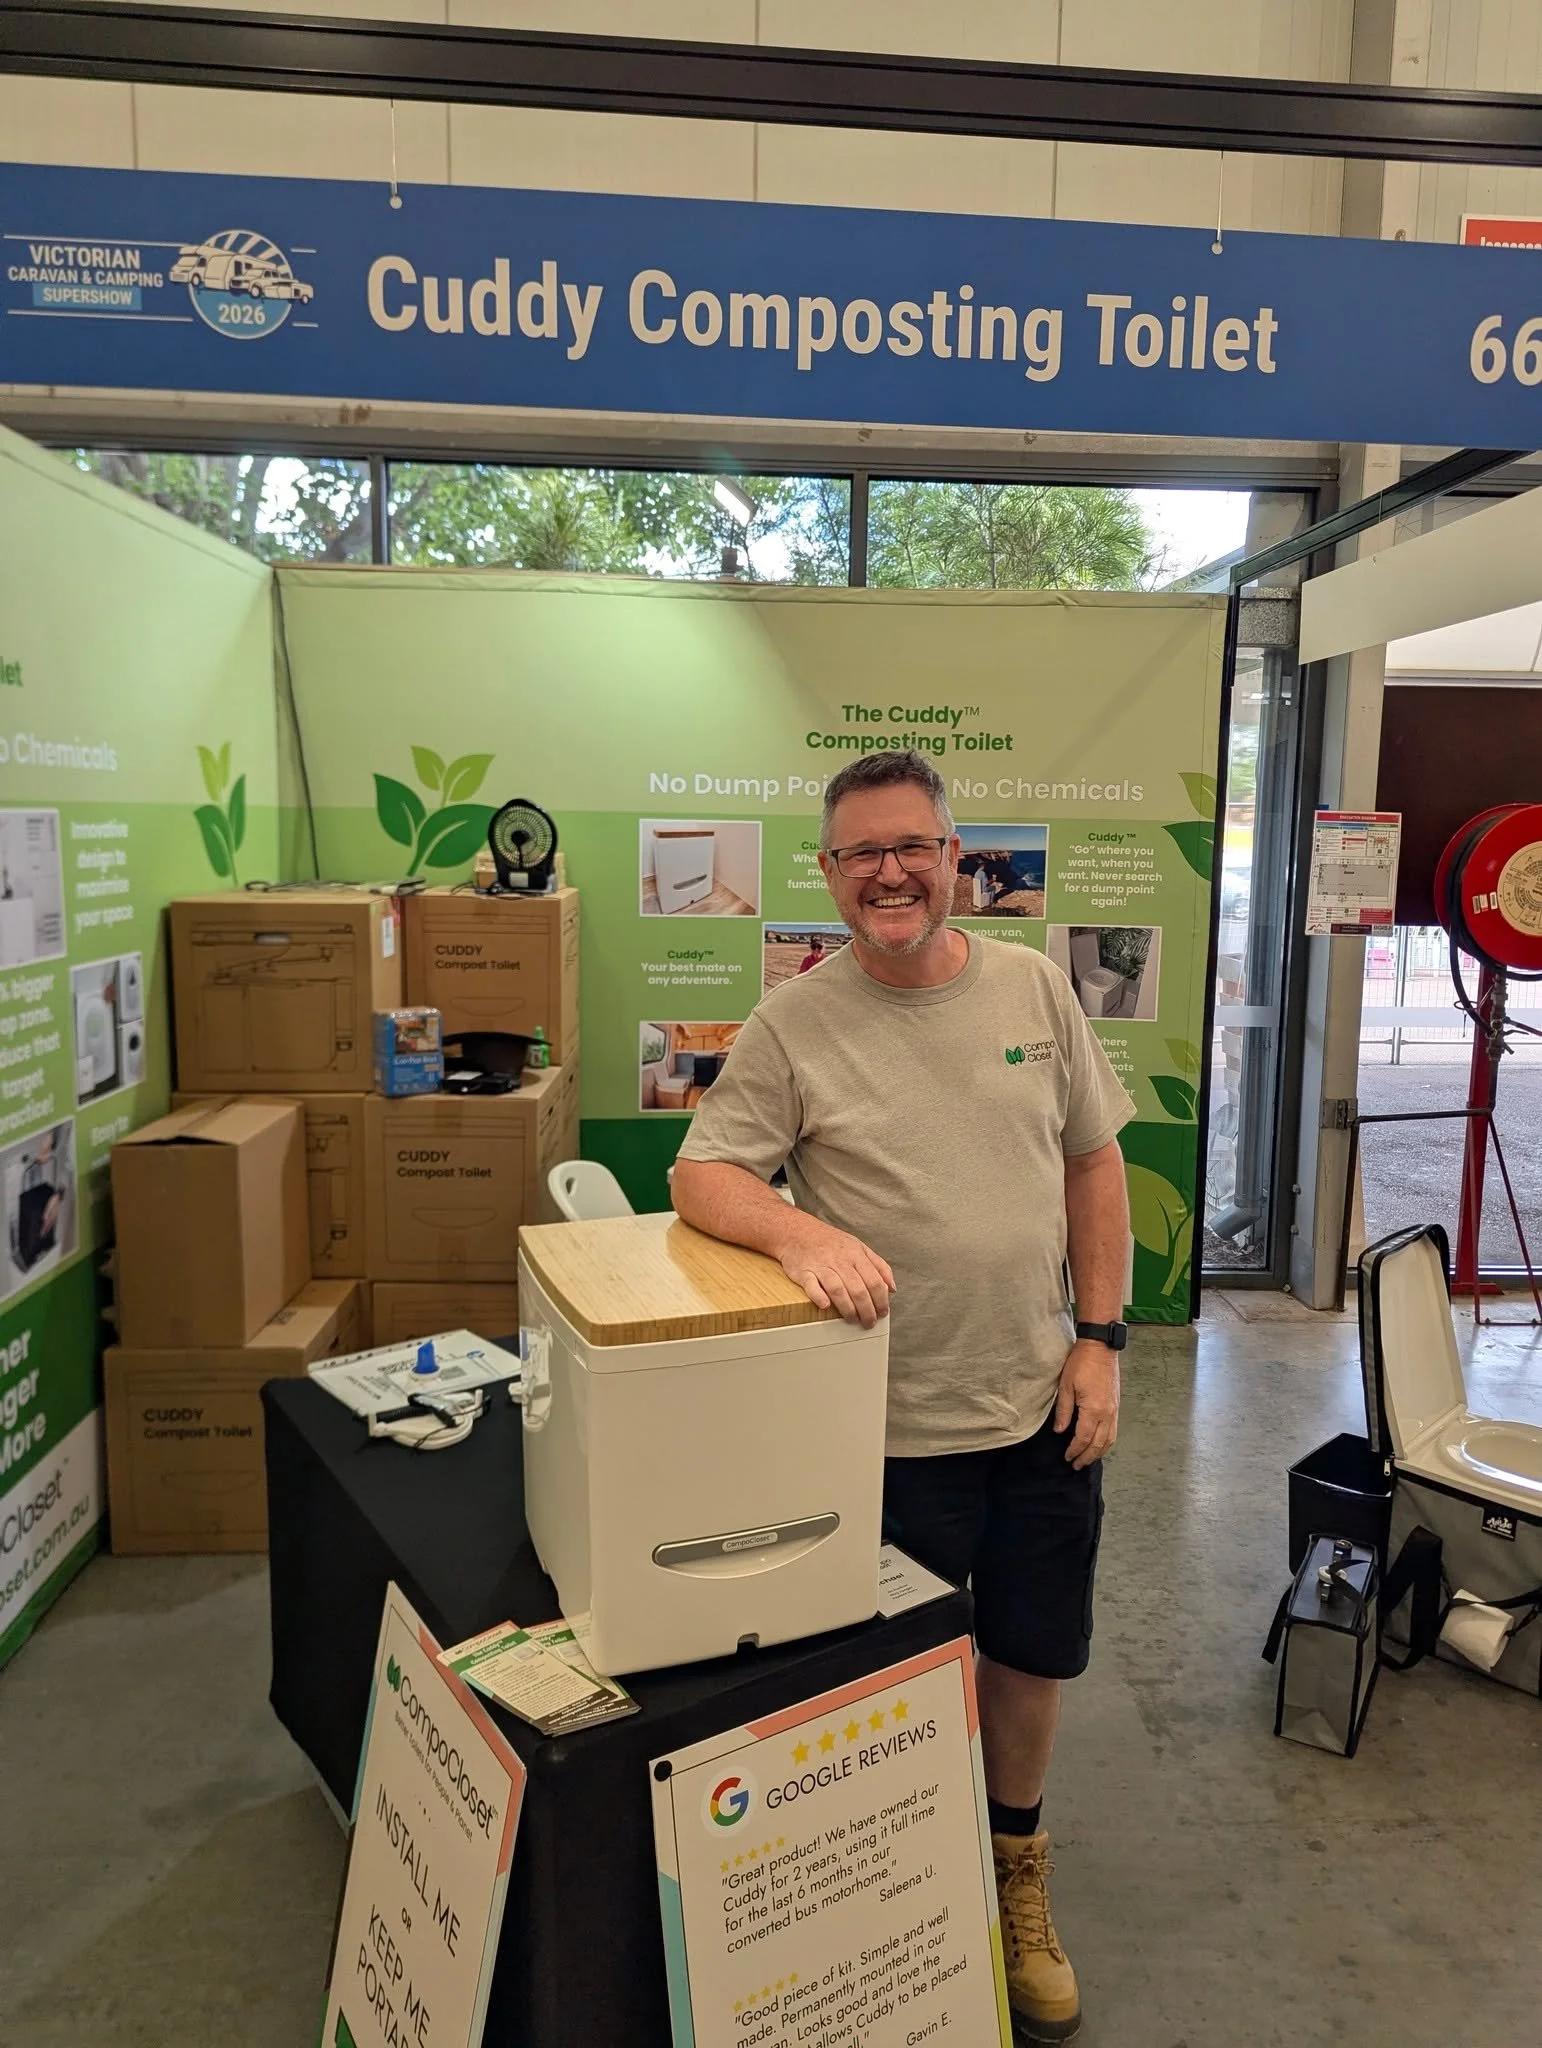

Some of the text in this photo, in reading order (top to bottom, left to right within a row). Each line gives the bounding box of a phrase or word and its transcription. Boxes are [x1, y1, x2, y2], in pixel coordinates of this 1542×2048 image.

[29, 244, 141, 270] VICTORIAN
[8, 266, 164, 288] CARAVAN & CAMPING
[43, 287, 133, 306] SUPERSHOW
[217, 303, 266, 326] 2026
[367, 255, 1279, 382] Cuddy Composting Toilet
[842, 704, 980, 729] The Cuddy™
[13, 732, 117, 772] Chemicals
[806, 731, 1013, 756] Composting Toilet
[649, 773, 1144, 802] No Dump Poi No Chemicals
[1088, 833, 1124, 846] Cuddy
[1097, 845, 1131, 856] where
[1133, 848, 1154, 858] you
[1068, 858, 1154, 871] want, when you
[787, 880, 829, 889] functio
[1058, 871, 1163, 883] want. Never search
[1064, 883, 1155, 896] for a dump point
[1091, 896, 1127, 908] again!
[1001, 928, 1025, 938] van,
[435, 944, 483, 956] CUDDY
[435, 960, 520, 972] Compost Toilet
[641, 963, 742, 973] Your best mate on
[647, 975, 733, 987] any adventure.
[1024, 1041, 1055, 1053] Compo
[1100, 1037, 1128, 1047] here
[397, 1150, 450, 1162] CUDDY
[396, 1167, 492, 1180] Compost Toilet
[143, 1408, 204, 1422] CUDDY
[143, 1426, 252, 1440] Compost Toilet
[726, 1535, 770, 1548] CompoCloset
[766, 1719, 937, 1809] GOOGLE REVIEWS
[432, 1770, 450, 1806] People
[455, 1809, 473, 1843] Planet
[722, 1783, 939, 1889] "Great product! We have owned our
[376, 1783, 460, 1958] INSTALL ME
[723, 1805, 935, 1913] Cuddy for 2 years, using it full time
[724, 1846, 891, 1934] for the last 6 months in our
[879, 1863, 937, 1902] Saleena U.
[401, 1907, 412, 1935] OR
[727, 1910, 792, 1954] converted
[794, 1902, 818, 1923] bus
[368, 1904, 430, 2048] KEEP ME
[735, 1905, 949, 2027] "Good piece of kit. Simple and well
[737, 1932, 946, 2048] made. Permanently mounted in our
[797, 2014, 833, 2041] Looks
[836, 1990, 868, 2024] good
[871, 1976, 893, 2000] and
[897, 1967, 920, 1986] love
[923, 1955, 941, 1972] the
[815, 2024, 853, 2048] allows
[856, 1998, 895, 2029] Cuddy
[898, 1993, 909, 2006] to
[912, 1983, 927, 1998] be
[931, 1954, 967, 1991] placed
[906, 2011, 952, 2047] Gavin E.
